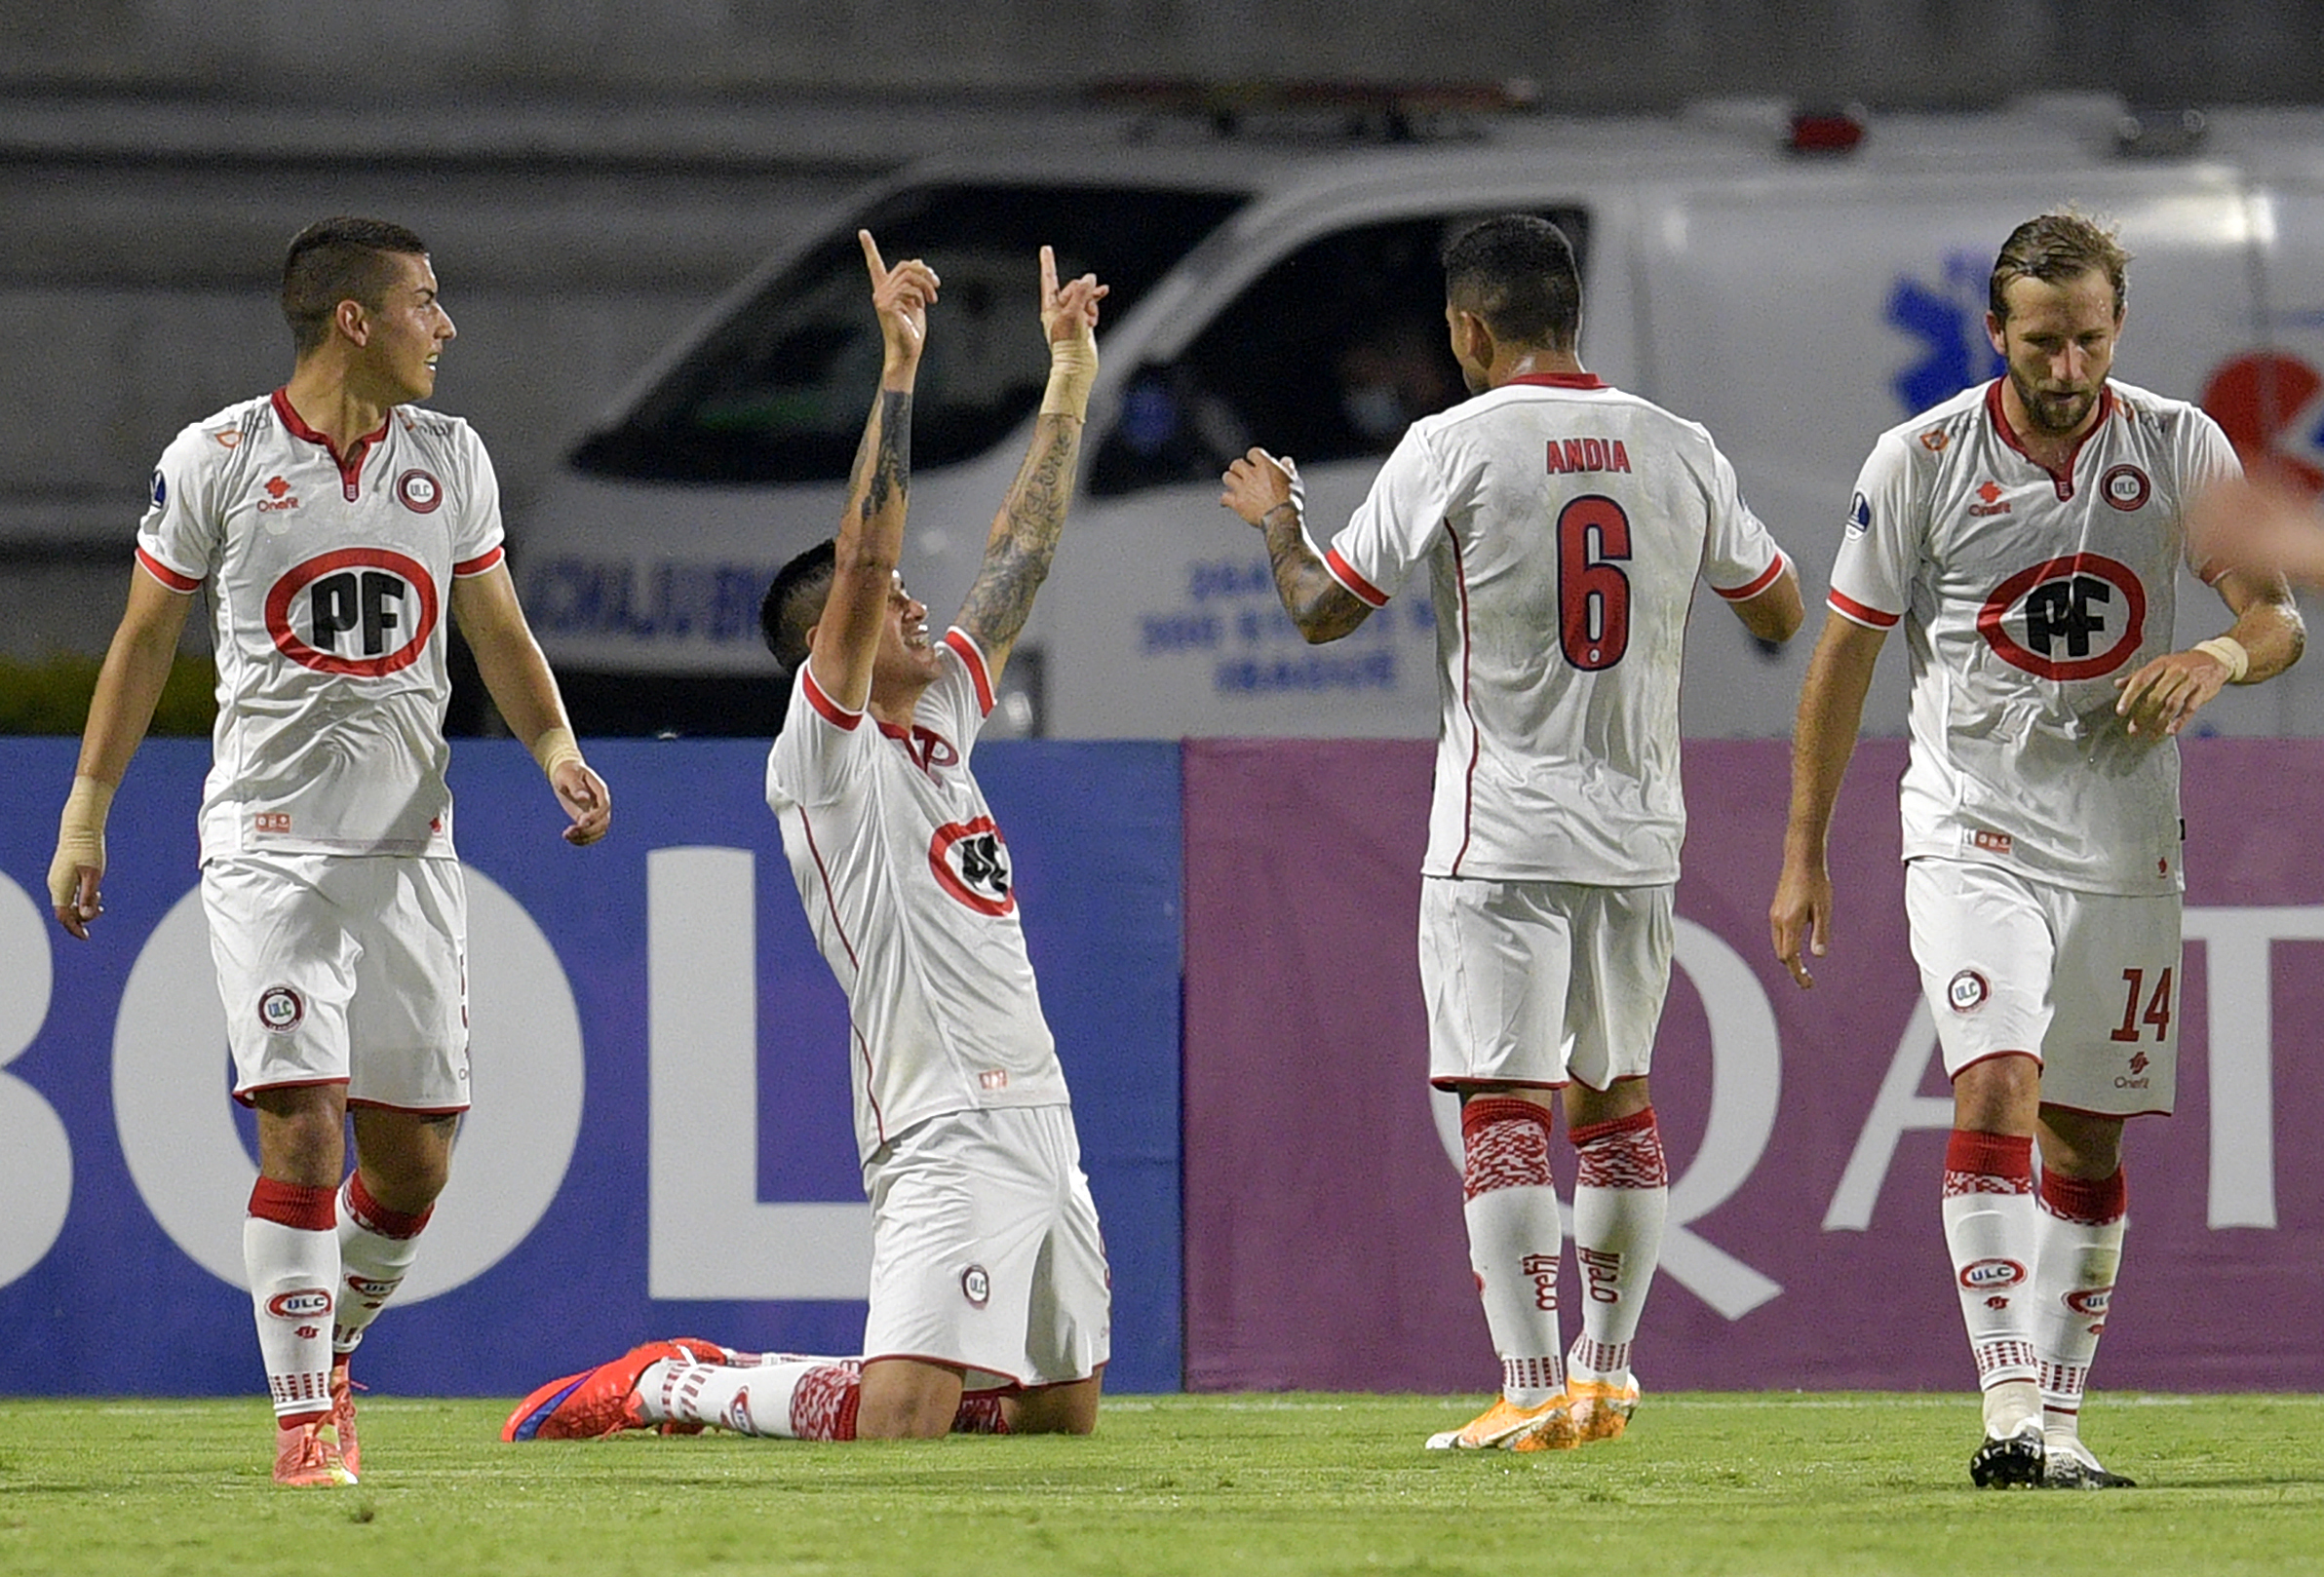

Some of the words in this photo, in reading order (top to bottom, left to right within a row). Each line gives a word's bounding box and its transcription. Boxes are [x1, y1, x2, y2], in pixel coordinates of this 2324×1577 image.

[1546, 438, 1632, 474] ANDIA
[311, 571, 406, 655] PF
[1556, 493, 1632, 673] 6
[2025, 575, 2111, 658] PF
[2110, 966, 2173, 1043] 14
[0, 845, 872, 1308] OL
[287, 1296, 326, 1310] ULC
[1971, 1266, 2012, 1282] ULC
